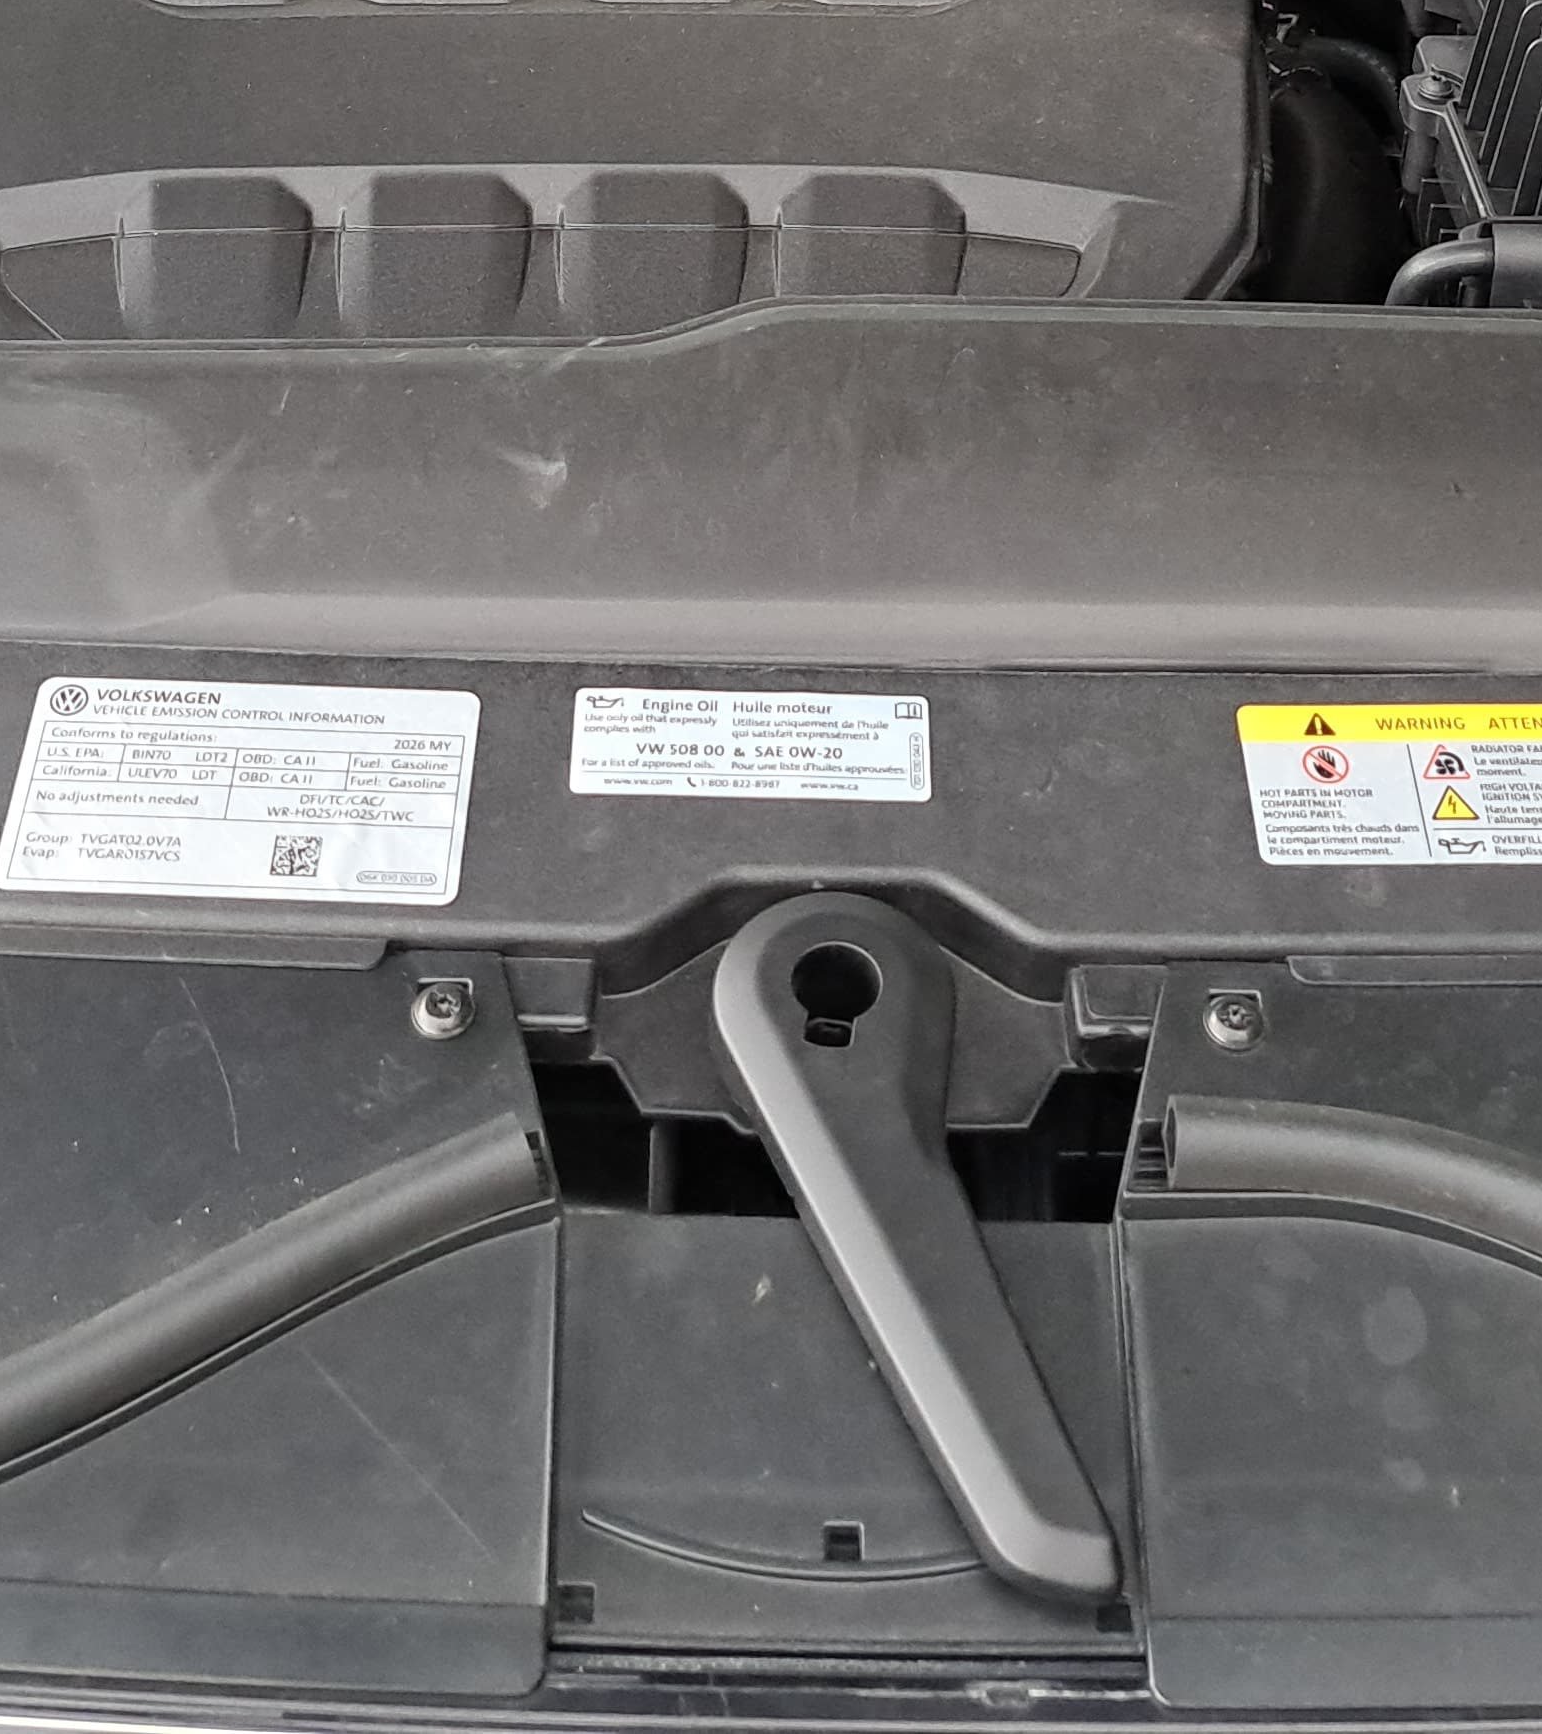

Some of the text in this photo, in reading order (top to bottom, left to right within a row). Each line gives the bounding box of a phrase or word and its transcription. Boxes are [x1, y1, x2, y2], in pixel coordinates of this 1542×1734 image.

[97, 688, 221, 705] VOLKSWAGEN
[643, 698, 718, 714] Engine Oil
[733, 701, 833, 715] Huile moteur
[93, 705, 385, 725] VEHICLE EMISSION CONTROL INFORMATION
[585, 713, 603, 721] Use
[646, 714, 667, 722] that
[670, 716, 717, 726] expressly
[732, 718, 771, 727] Utilisez
[774, 719, 838, 728] uniquement
[841, 720, 854, 728] de
[1375, 717, 1466, 730] WARNING
[51, 727, 216, 743] Conforms to regulations:
[584, 725, 629, 734] complies
[732, 729, 749, 738] qui
[394, 739, 452, 751] 2026 MY
[636, 743, 843, 759] VW 508 00 & SAE 0W-20
[1470, 745, 1524, 753] RADIATOR
[75, 747, 104, 758] EPA:
[132, 749, 228, 763] BIN70 LDT2
[242, 753, 276, 765] OBD:
[284, 754, 303, 765] CA
[353, 757, 448, 771] Fuel: Gasoline
[628, 758, 639, 766] of
[641, 760, 691, 769] approved
[1474, 757, 1487, 765] Le
[731, 761, 754, 770] Pour
[128, 768, 217, 780] ULEV70 LDT
[239, 771, 300, 784] OBD: CA
[350, 776, 446, 789] Fuel: Gasoline
[36, 790, 199, 806] No adjustments needed
[1260, 789, 1373, 797] HOT PARTS IN MOTOR
[1482, 793, 1530, 801] IGNITION
[1263, 810, 1308, 818] MOVING
[1485, 805, 1518, 814] Haute
[1265, 824, 1330, 834] Composants
[1355, 824, 1392, 833] chauds
[1395, 824, 1419, 833] dans
[26, 831, 71, 846] Group:
[1280, 836, 1358, 846] compartiment
[22, 846, 58, 859] Evap:
[1269, 846, 1304, 856] Pièces
[1307, 848, 1320, 856] en
